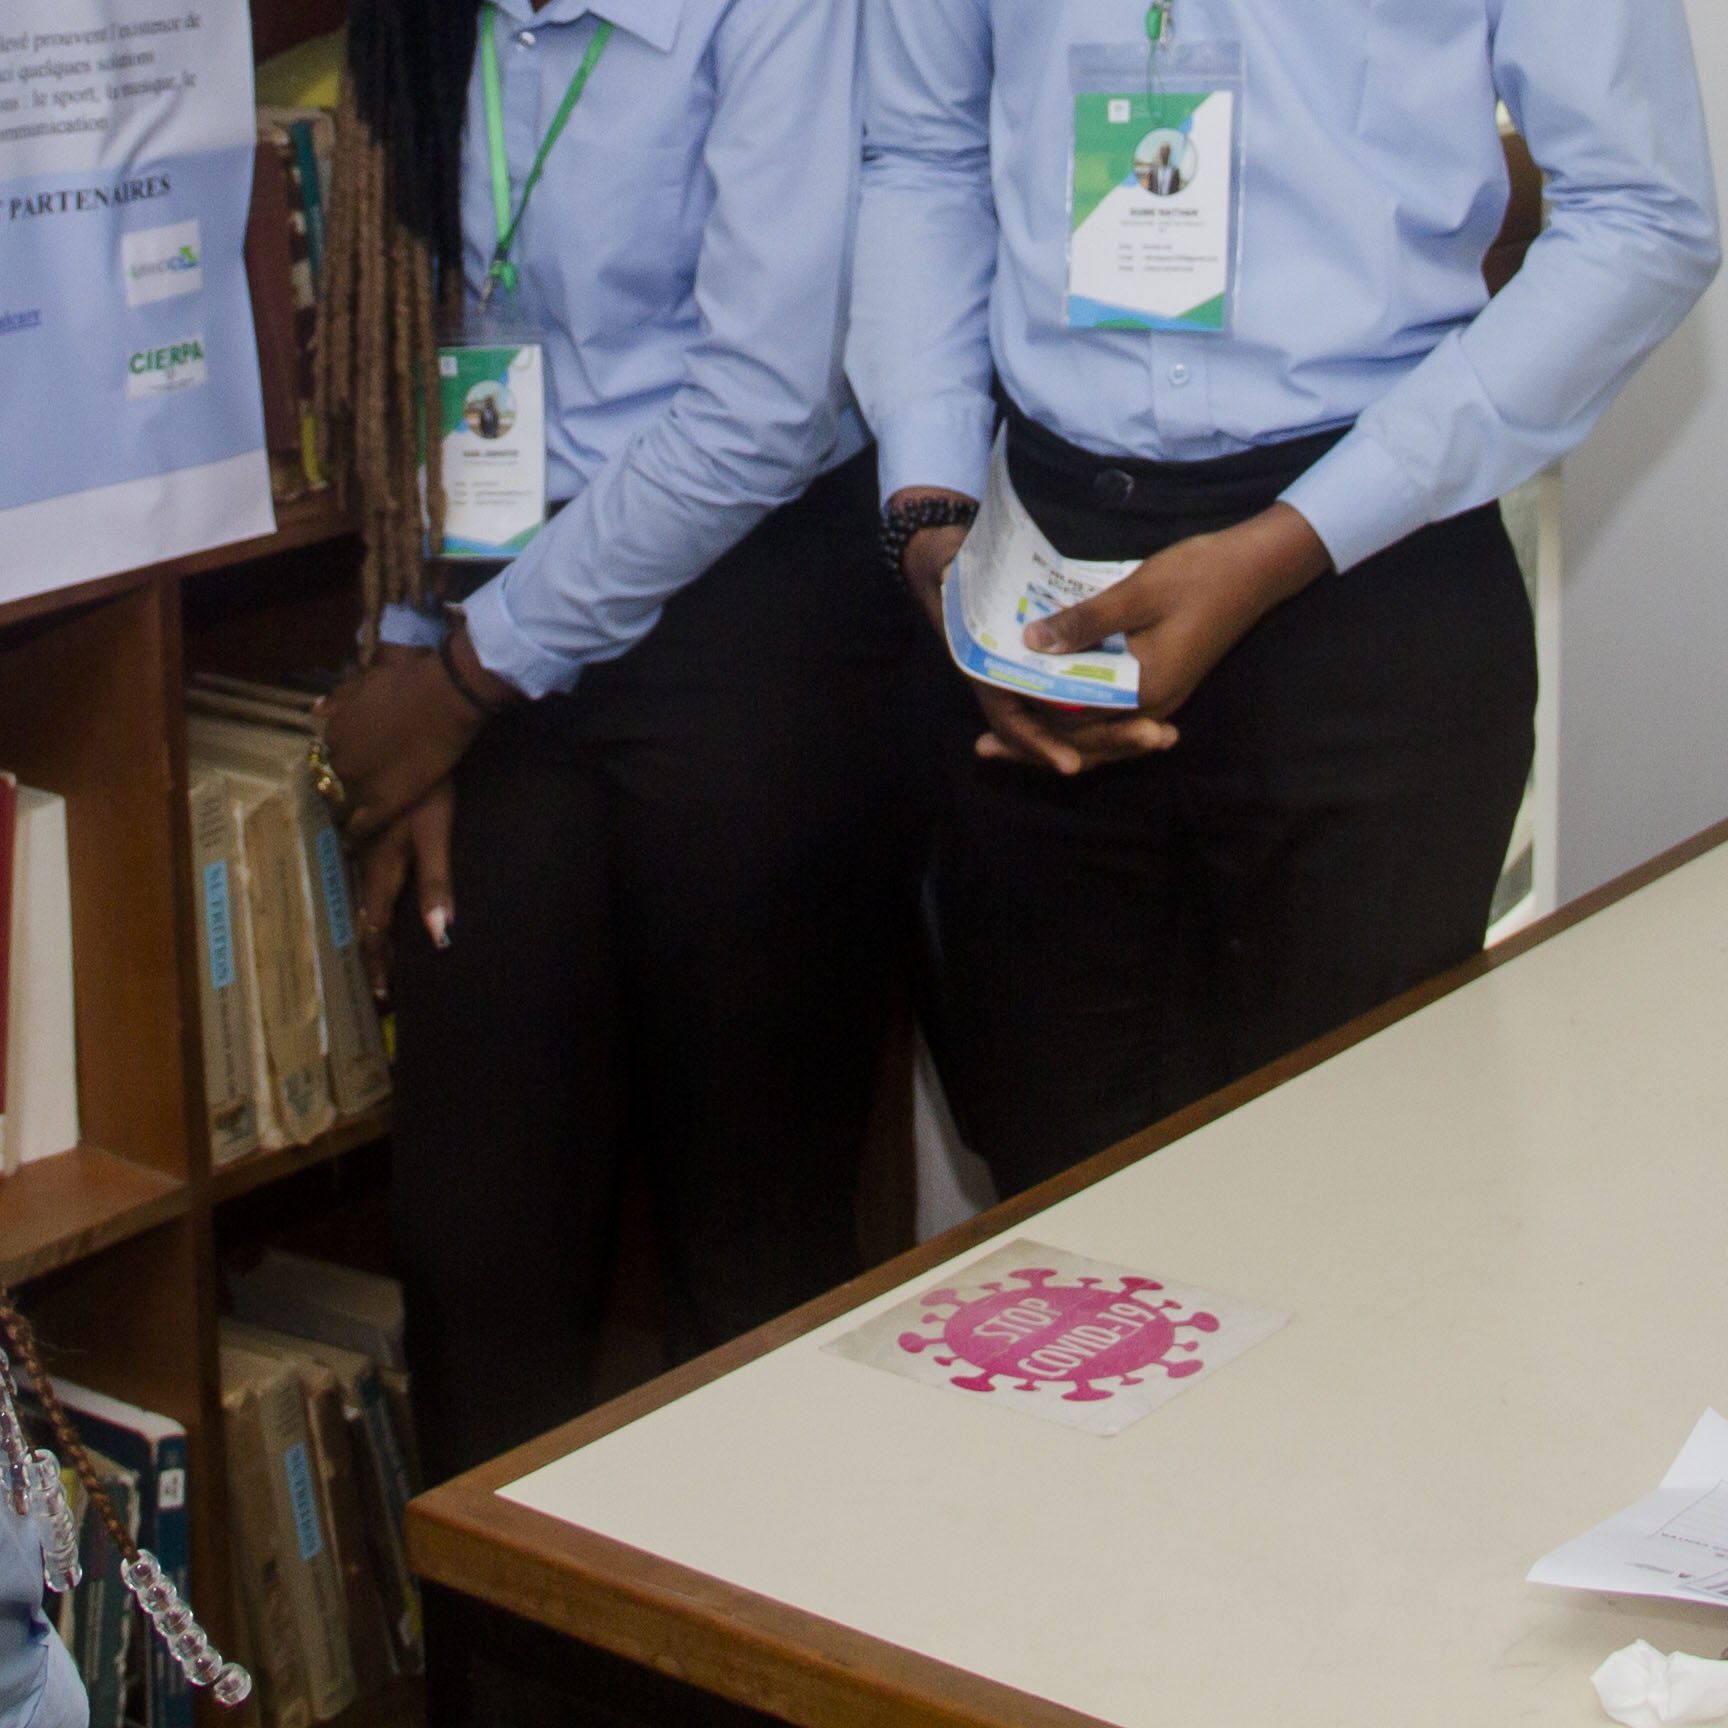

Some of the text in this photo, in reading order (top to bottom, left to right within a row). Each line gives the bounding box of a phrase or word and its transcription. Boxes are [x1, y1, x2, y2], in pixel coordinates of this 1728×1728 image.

[9, 174, 172, 220] PARTENAIRES
[129, 339, 203, 375] CIERPA
[971, 1297, 1063, 1344] STOP
[1017, 1303, 1157, 1377] COVID-19
